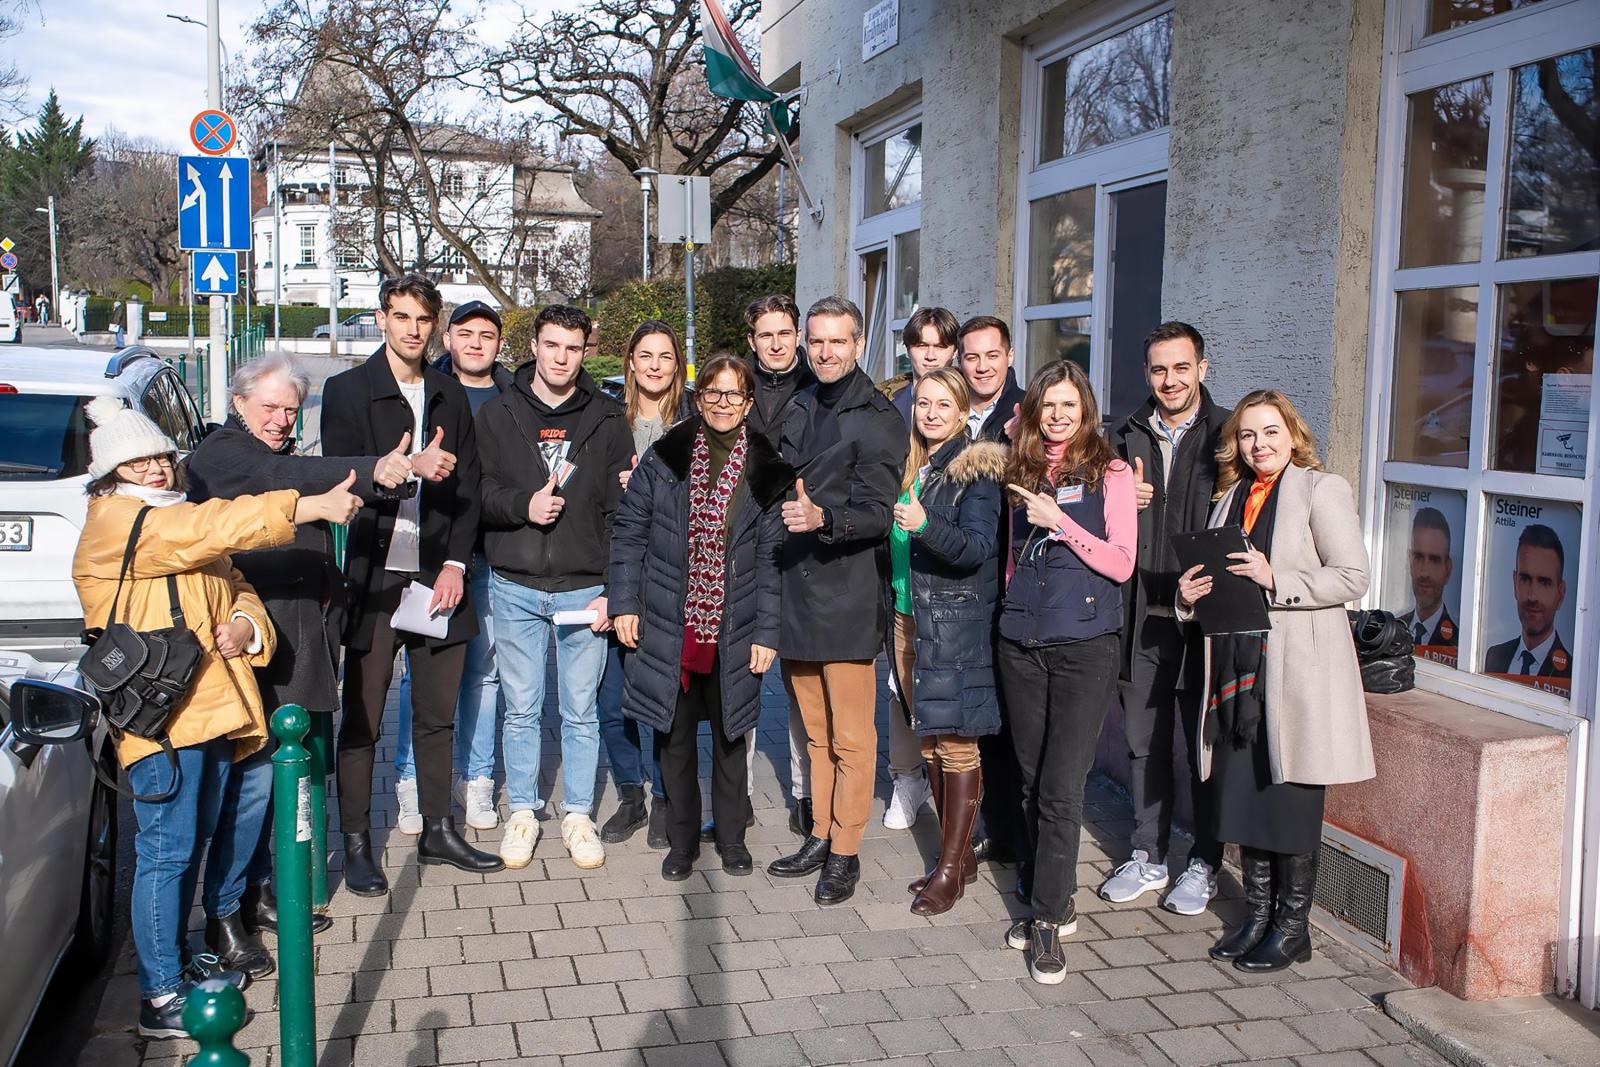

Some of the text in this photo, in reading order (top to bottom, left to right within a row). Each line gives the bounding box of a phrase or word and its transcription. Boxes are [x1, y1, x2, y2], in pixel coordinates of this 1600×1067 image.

[539, 429, 567, 439] PRIDE
[1392, 486, 1432, 503] Steiner
[1496, 499, 1543, 519] Steiner
[1494, 516, 1516, 527] Attila
